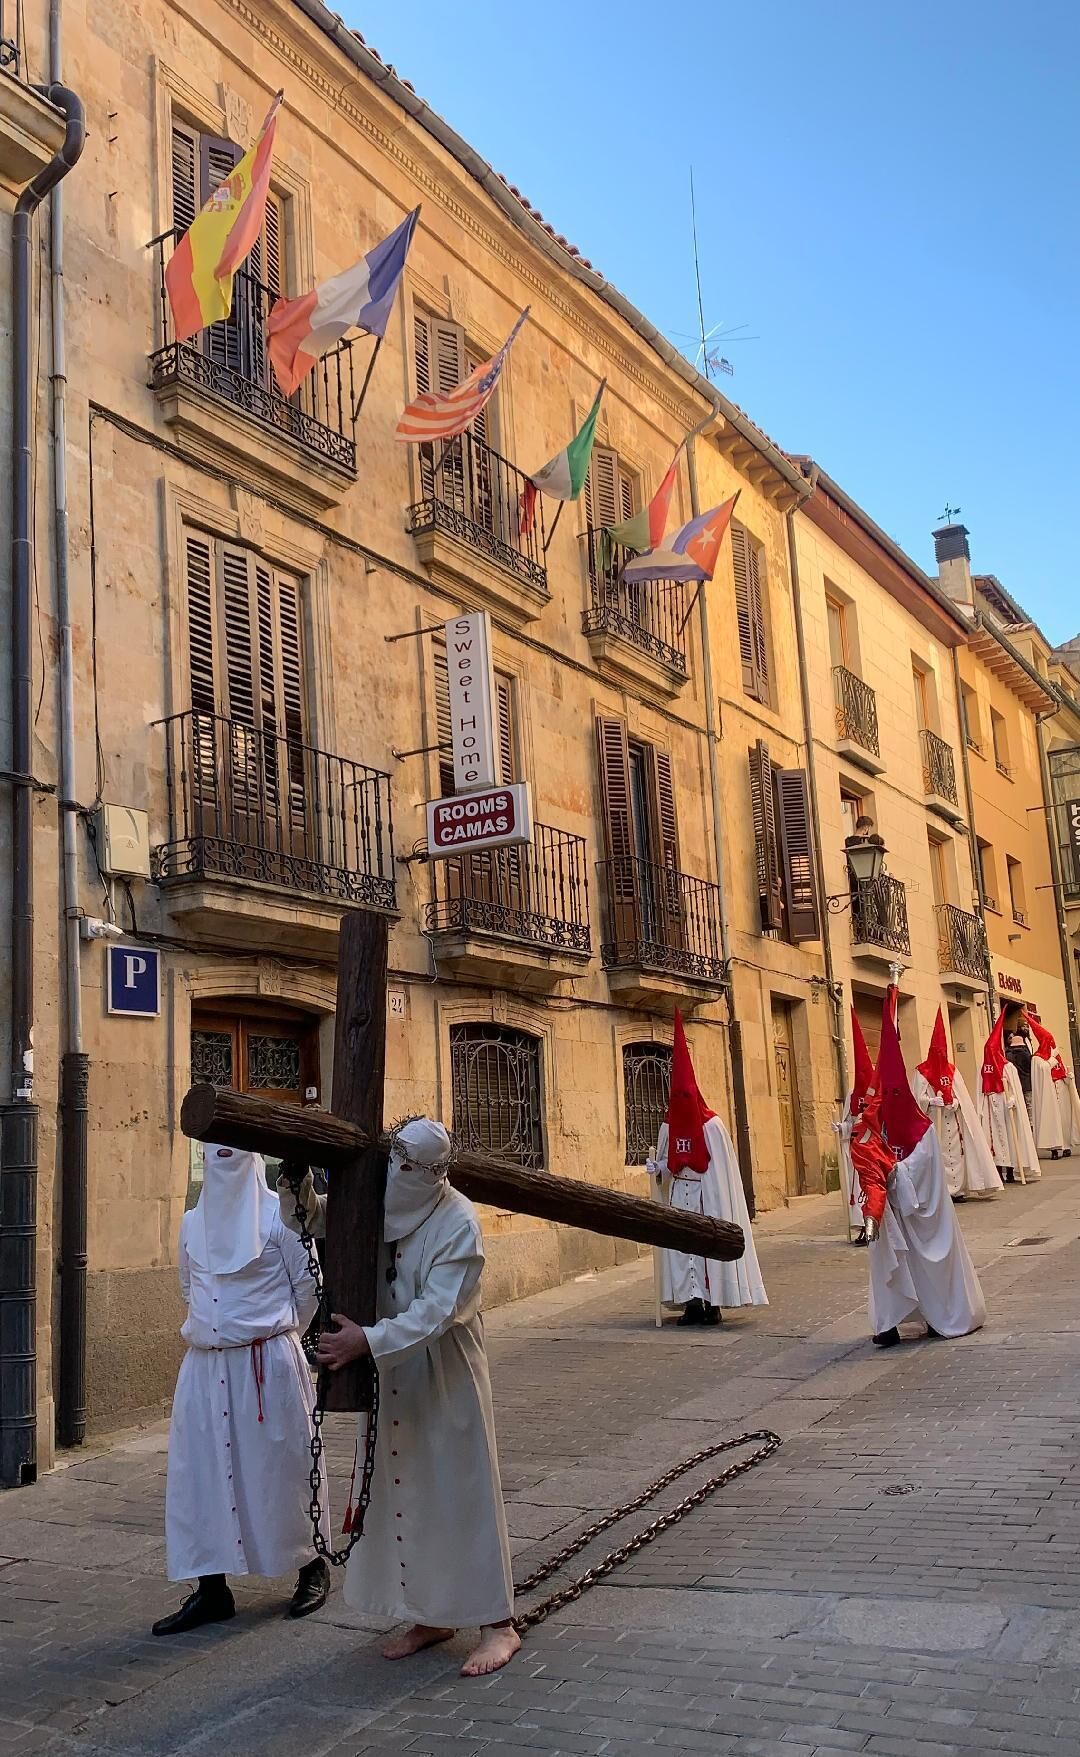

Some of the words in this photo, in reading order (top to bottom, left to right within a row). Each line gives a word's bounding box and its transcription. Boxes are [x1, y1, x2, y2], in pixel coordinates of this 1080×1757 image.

[454, 620, 473, 703] Sweet
[460, 715, 481, 782] Home
[439, 795, 508, 823] ROOMS
[440, 815, 508, 842] CAMAS
[123, 955, 147, 989] P
